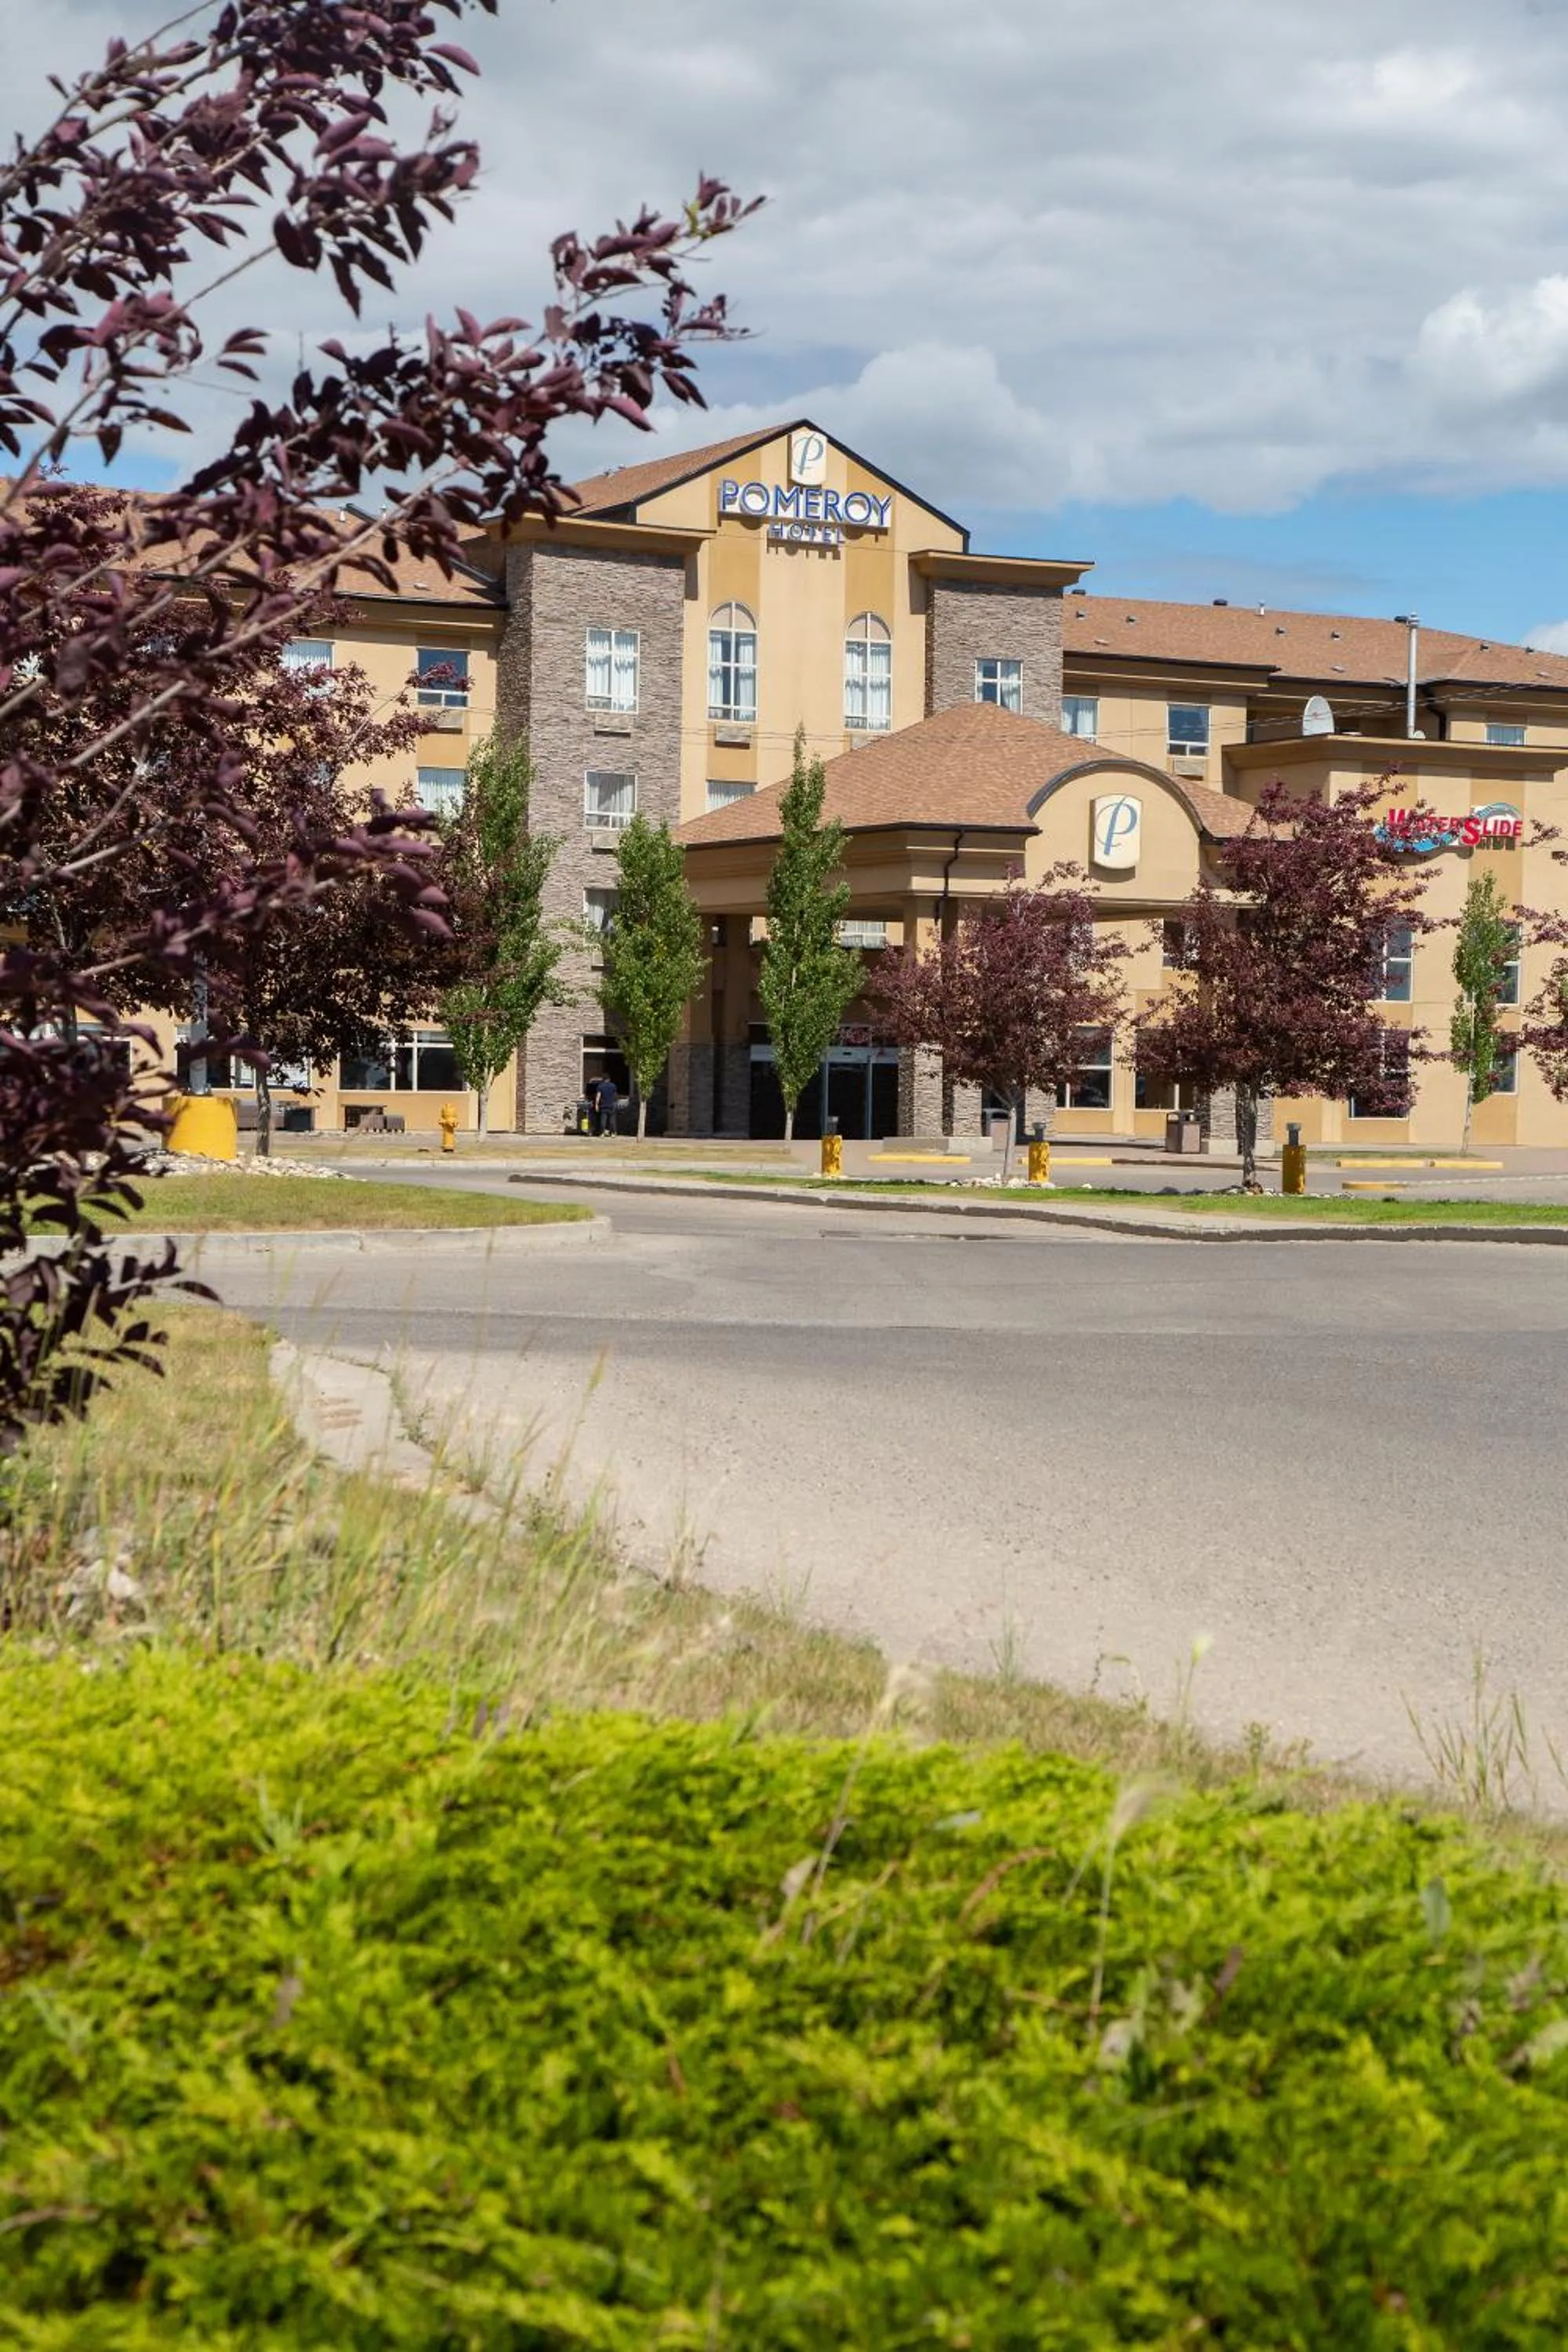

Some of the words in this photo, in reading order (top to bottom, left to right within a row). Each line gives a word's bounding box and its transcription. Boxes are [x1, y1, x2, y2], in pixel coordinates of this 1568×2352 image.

[793, 434, 824, 475] P
[720, 479, 891, 526] POMEROY
[769, 521, 845, 543] HOTEL
[1095, 794, 1138, 855] P
